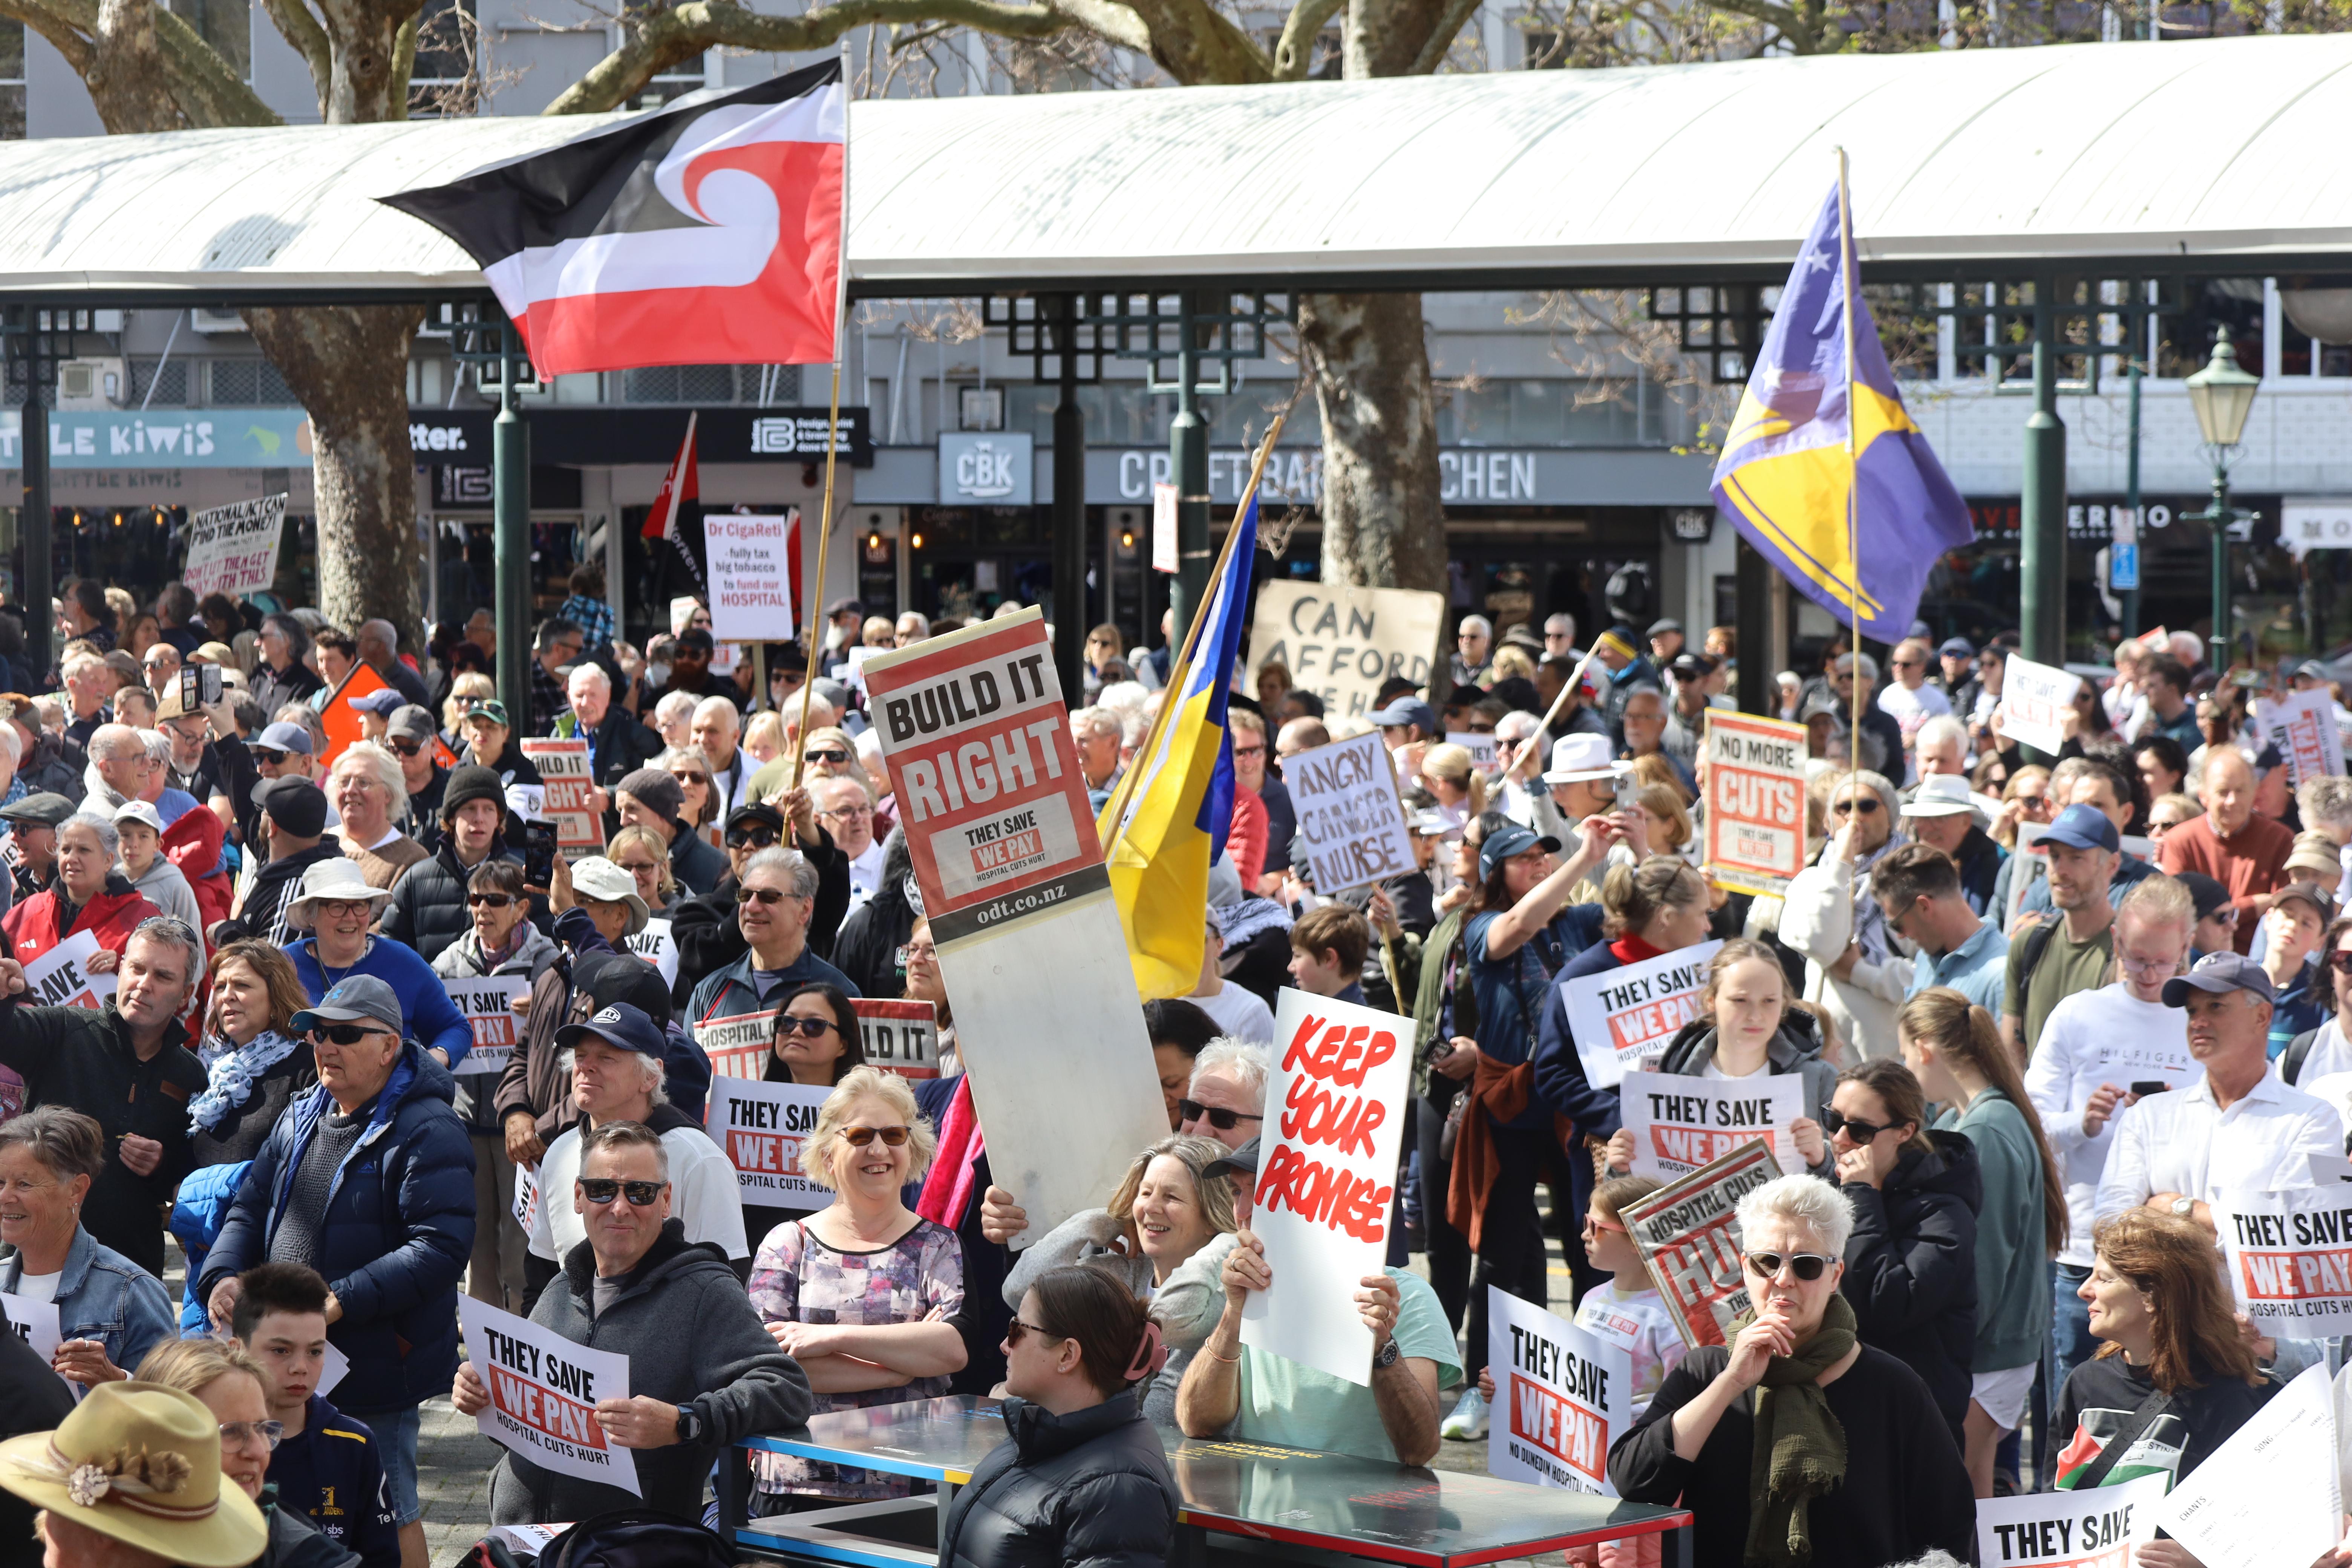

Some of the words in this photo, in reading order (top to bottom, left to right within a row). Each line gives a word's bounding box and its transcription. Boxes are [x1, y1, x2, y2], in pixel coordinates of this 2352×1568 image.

[408, 423, 467, 451] tter.
[835, 417, 855, 429] rint
[956, 453, 1015, 487] CBK
[1440, 453, 1537, 499] CHEN
[190, 528, 214, 547] FIND
[217, 522, 234, 539] THE
[708, 523, 723, 537] Dr
[1970, 506, 2021, 529] OVE
[250, 551, 270, 565] GET
[671, 526, 702, 583] orkers
[715, 562, 732, 575] big
[734, 562, 776, 573] tobacco
[754, 548, 770, 559] tax
[721, 592, 785, 608] HOSPITAL
[724, 580, 735, 589] to
[737, 579, 760, 589] fund
[1291, 596, 1375, 640] CAN
[1259, 638, 1430, 683] AFFORD
[885, 670, 1001, 743] BUILD
[1006, 653, 1044, 704] IT
[534, 756, 564, 773] UILD
[567, 757, 581, 773] IT
[900, 716, 1063, 823] RIGHT
[1471, 746, 1490, 761] HEY
[1720, 736, 1741, 759] NO
[1748, 740, 1794, 770] MORE
[1299, 742, 1374, 799] ANGRY
[1718, 770, 1796, 825] CUTS
[965, 821, 1001, 846] THEY
[1003, 810, 1037, 835] SAVE
[1302, 787, 1395, 844] CANCER
[976, 842, 1007, 868] WE
[1005, 831, 1037, 860] PAY
[1312, 831, 1403, 890] NURSE
[977, 866, 1009, 882] HOSPITAL
[1010, 859, 1027, 871] CUTS
[1029, 853, 1046, 865] HURT
[977, 885, 1067, 924] odt.co.nz
[473, 991, 510, 1014] SAVE
[1597, 977, 1652, 1012] THEY
[1658, 962, 1706, 994] SAVE
[473, 1018, 506, 1045] PAY
[701, 1022, 766, 1048] HOSPITAL
[1615, 1006, 1663, 1044] WE
[476, 1047, 495, 1059] CUTS
[902, 1026, 925, 1060] IT
[1282, 1014, 1396, 1089] KEEP
[1616, 1040, 1664, 1063] HOSPITAL
[2099, 1047, 2188, 1065] HILFIGER
[729, 1098, 780, 1129] THEY
[785, 1104, 822, 1132] SAV
[1280, 1073, 1386, 1159] YOUR
[1647, 1093, 1709, 1124] THEY
[1715, 1098, 1773, 1126] SAVE
[734, 1133, 777, 1171] WE
[1659, 1128, 1708, 1165] WE
[518, 1173, 531, 1223] SAVE
[779, 1178, 806, 1191] CUTS
[1254, 1144, 1392, 1243] PROMISE
[1646, 1189, 1726, 1243] HOSPITAL
[1722, 1166, 1767, 1204] CUTS
[2232, 1213, 2287, 1246] THEY
[2293, 1208, 2352, 1245] SAVE
[1663, 1225, 1745, 1307] HU
[2246, 1255, 2299, 1295] WE
[2295, 1253, 2352, 1294] PAY
[1597, 1311, 1611, 1323] SAVE
[1609, 1315, 1622, 1328] WE
[1620, 1319, 1636, 1334] PAY
[2248, 1303, 2303, 1317] HOSPITAL
[2305, 1300, 2339, 1316] CUTS
[483, 1326, 540, 1379] THEY
[545, 1354, 596, 1405] SAVE
[1509, 1323, 1560, 1385] THEY
[1565, 1351, 1608, 1413] SAVE
[496, 1371, 541, 1426] WE
[543, 1392, 591, 1444] PAY
[2309, 1415, 2322, 1427] VERSE
[496, 1410, 542, 1447] HOSPITAL
[544, 1436, 574, 1458] CUTS
[577, 1447, 610, 1466] HURT
[1518, 1381, 1558, 1449] WE
[1559, 1402, 1601, 1471] PAY
[1509, 1440, 1520, 1459] NO
[1521, 1447, 1550, 1475] DUNEDIN
[2254, 1435, 2274, 1453] SONG
[377, 1513, 391, 1525] Te
[2179, 1496, 2207, 1521] CHANTS
[327, 1523, 344, 1535] sbs
[1993, 1519, 2073, 1560] THEY
[2081, 1503, 2134, 1551] SAVE
